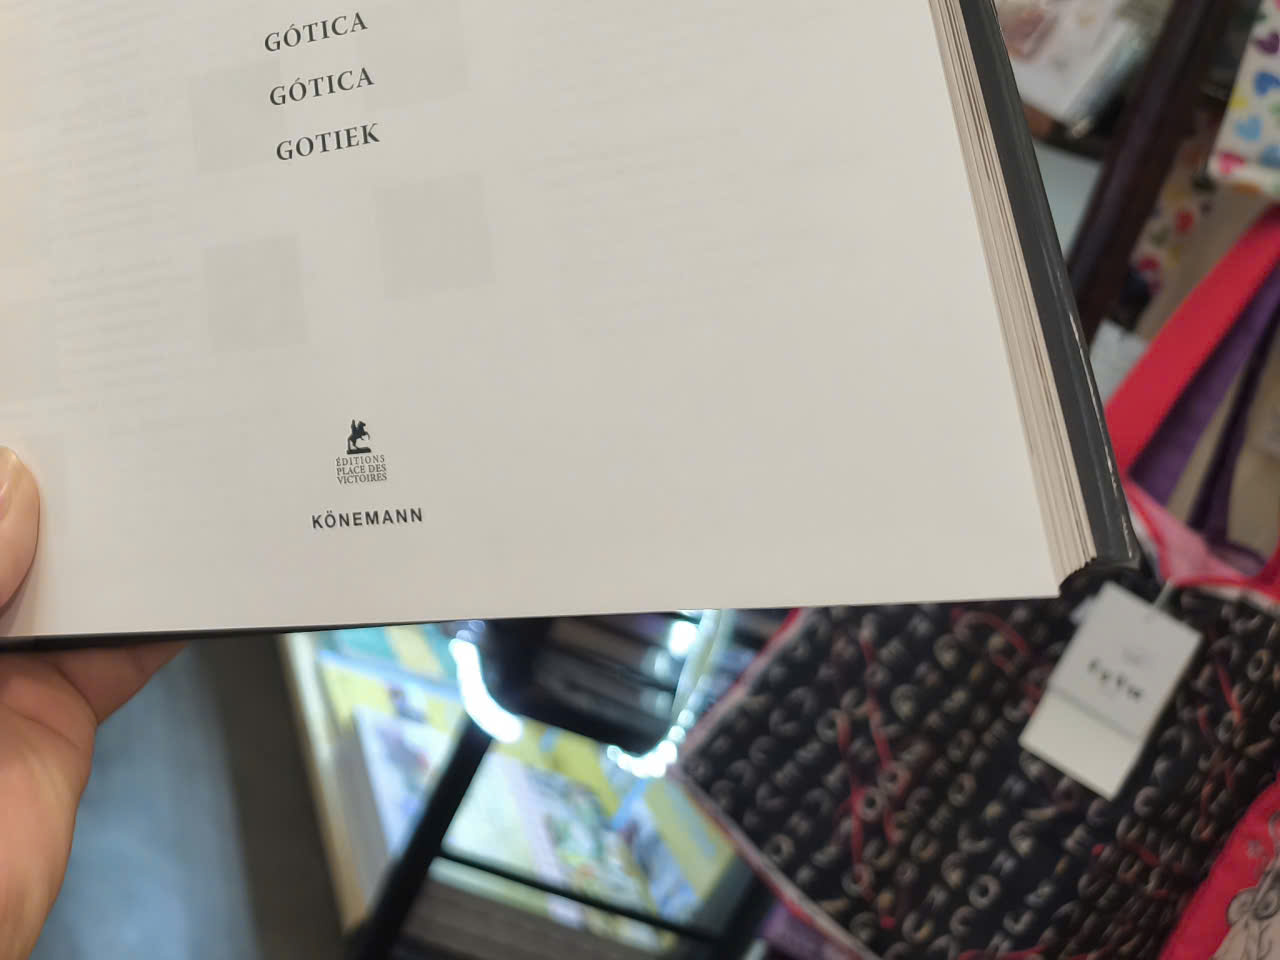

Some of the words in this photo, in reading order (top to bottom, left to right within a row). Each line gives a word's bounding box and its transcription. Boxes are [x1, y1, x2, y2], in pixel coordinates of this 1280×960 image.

[264, 11, 369, 53] GÓTICA
[269, 66, 375, 106] GÓTICA
[276, 122, 381, 161] GOTIEK
[335, 454, 385, 467] ÉDITIONS
[336, 465, 366, 476] PLACE
[367, 463, 387, 473] DES
[336, 472, 388, 485] VICTOIRES
[311, 507, 423, 530] KÖNEMANN
